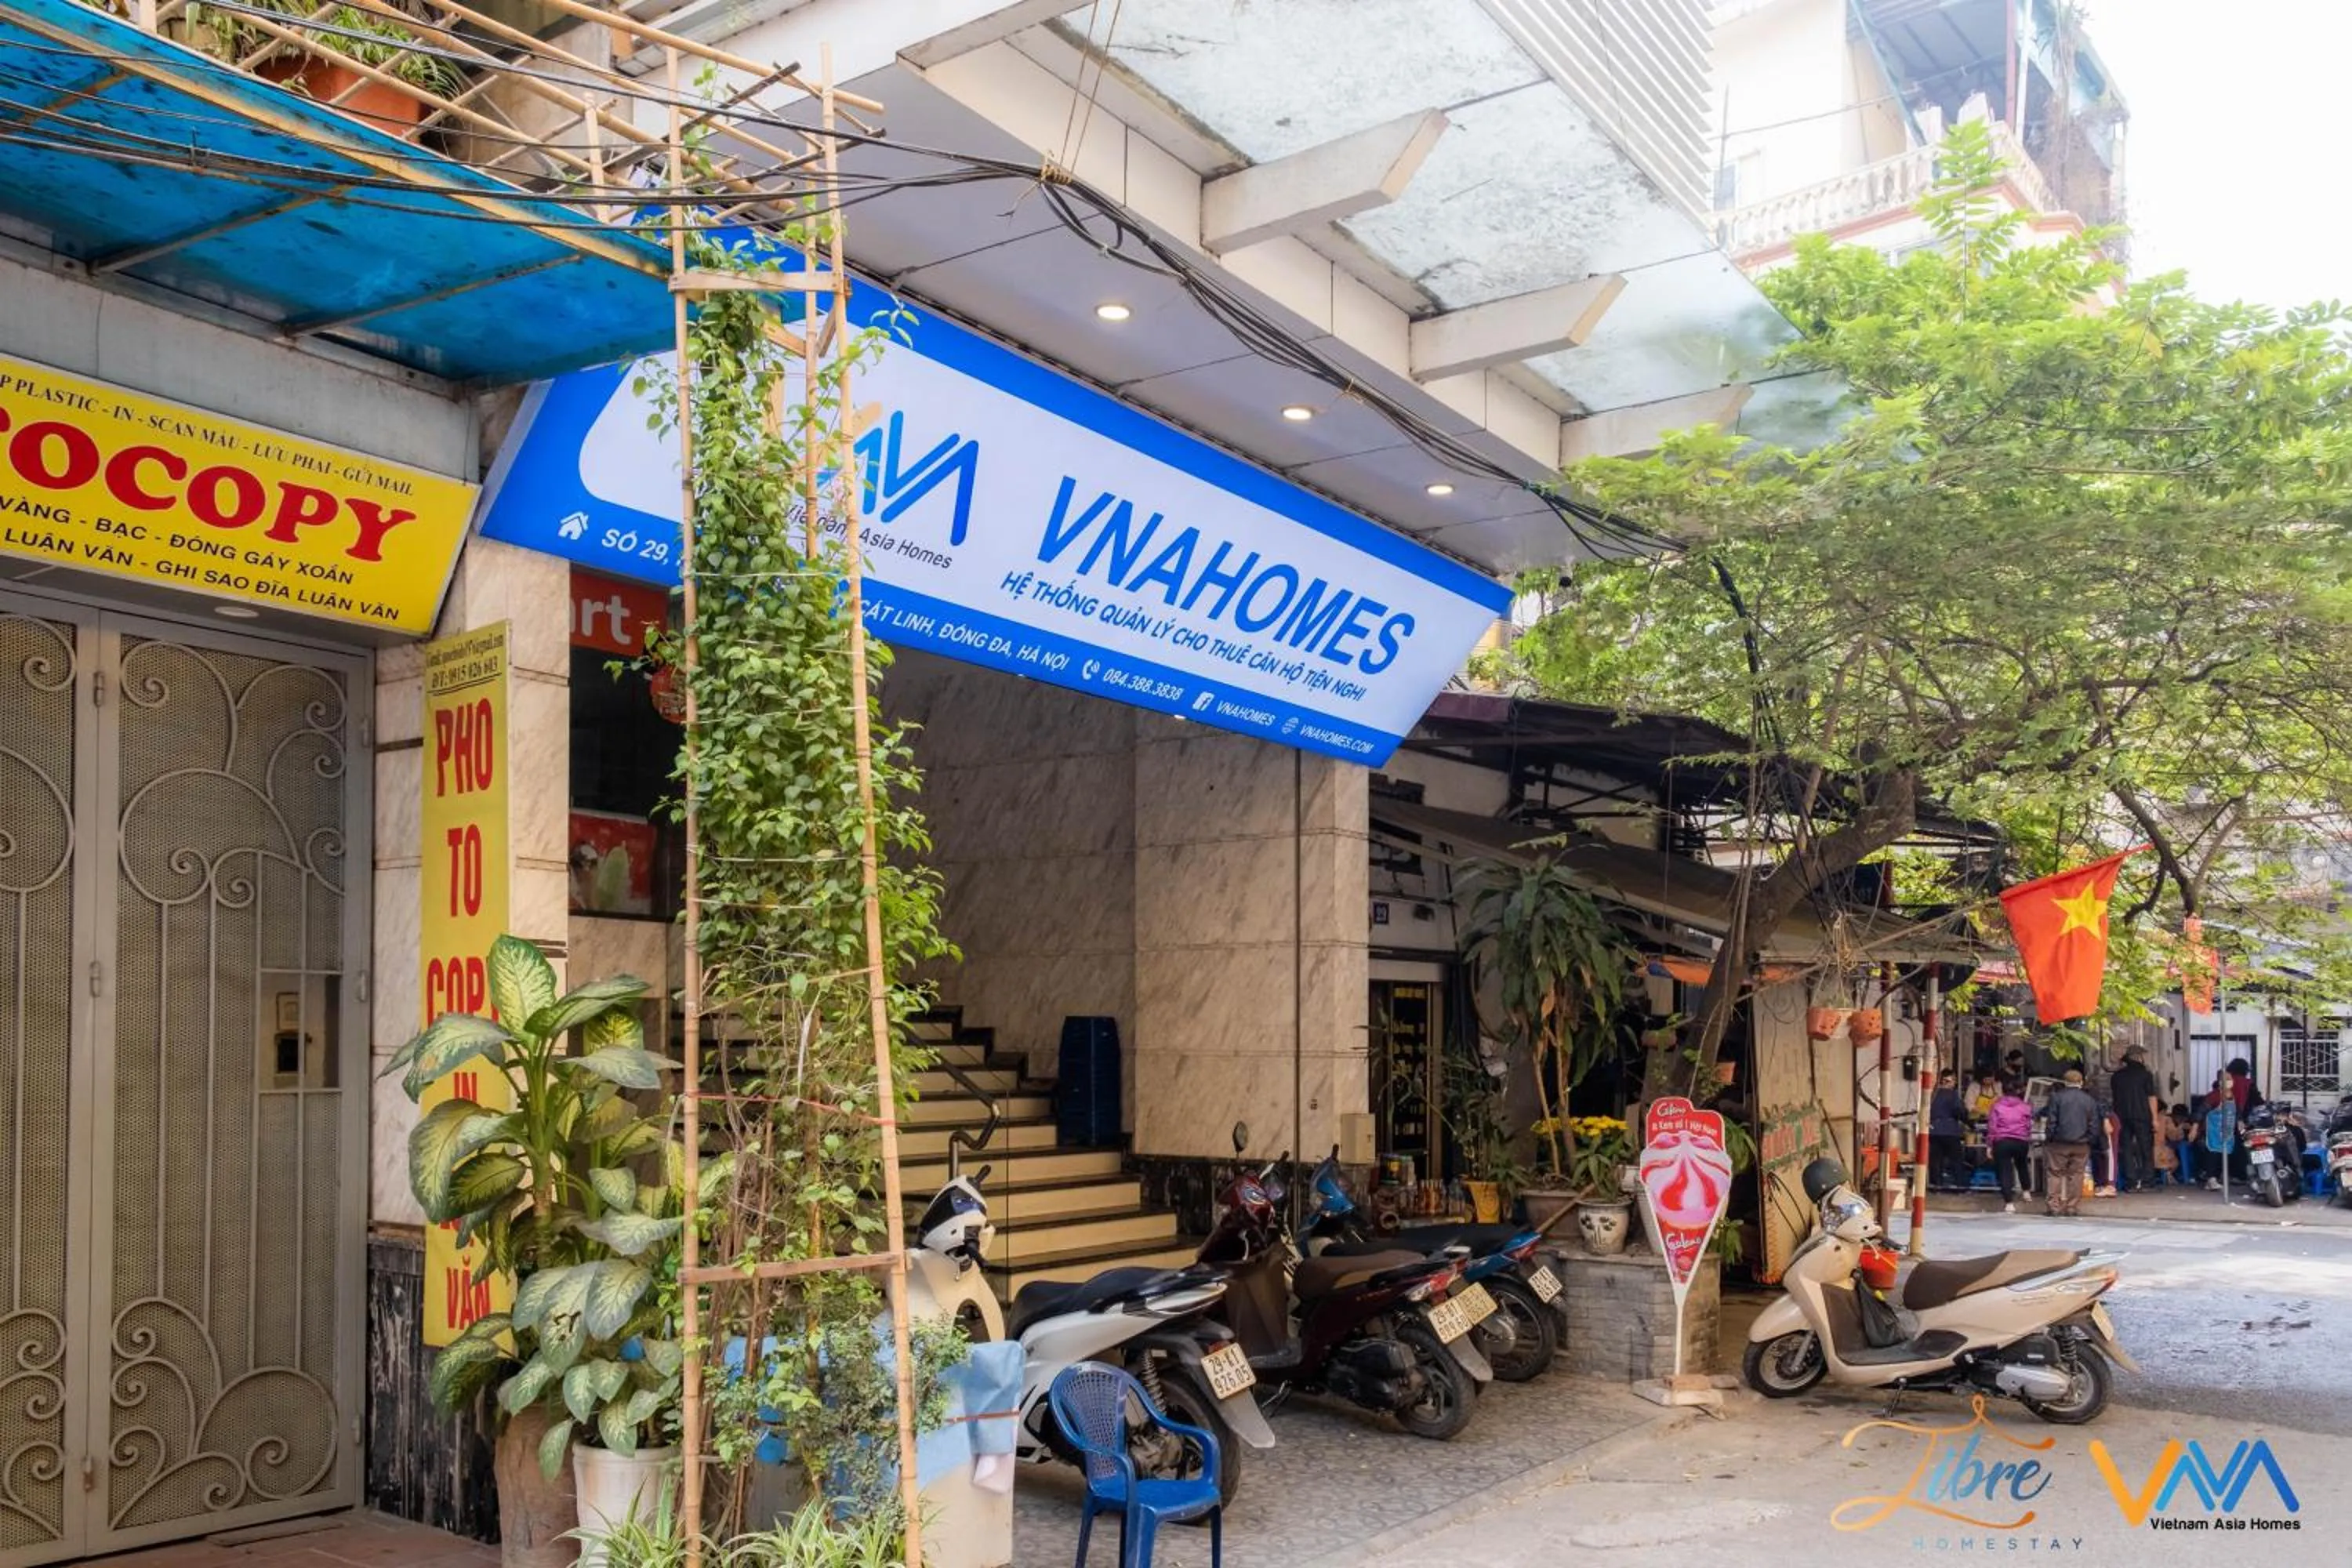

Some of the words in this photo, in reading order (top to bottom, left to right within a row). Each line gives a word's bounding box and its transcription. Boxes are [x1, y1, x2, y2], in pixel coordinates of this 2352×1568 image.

[0, 407, 417, 563] OCOPY
[15, 379, 100, 413] PLASTIC
[113, 405, 135, 422] IN
[148, 415, 197, 437] SCAN
[373, 474, 414, 495] MAIL
[0, 495, 71, 524] VÀNG
[95, 517, 148, 541] BẠC
[169, 533, 237, 560] ĐÓNG
[244, 550, 291, 572] GÁY
[4, 528, 75, 554] LUẬN
[83, 543, 133, 565] VĂN
[155, 560, 198, 579] GHI
[203, 570, 249, 590] SAO
[255, 579, 290, 598] ĐĨA
[297, 590, 353, 611] LUẬN
[359, 601, 400, 621] VĂN
[858, 527, 895, 551] Asia
[897, 539, 953, 569] Homes
[1036, 474, 1416, 676] VNAHOMES
[570, 594, 633, 646] rt
[639, 538, 670, 566] 29,
[892, 611, 936, 637] LINH,
[1102, 667, 1185, 700] 084.388.3838
[1215, 700, 1276, 727] VNAHOMES
[1299, 724, 1375, 754] VNAHOMES.COM
[1000, 571, 1035, 601] HỆ
[1032, 579, 1099, 617] THỐNG
[1152, 618, 1178, 640] LÝ
[1172, 627, 1209, 652] CHO
[1208, 639, 1253, 666] THUÊ
[1329, 679, 1368, 702] NGHI
[434, 697, 494, 798] PHO
[447, 823, 482, 918] TO
[426, 956, 500, 1029] COP
